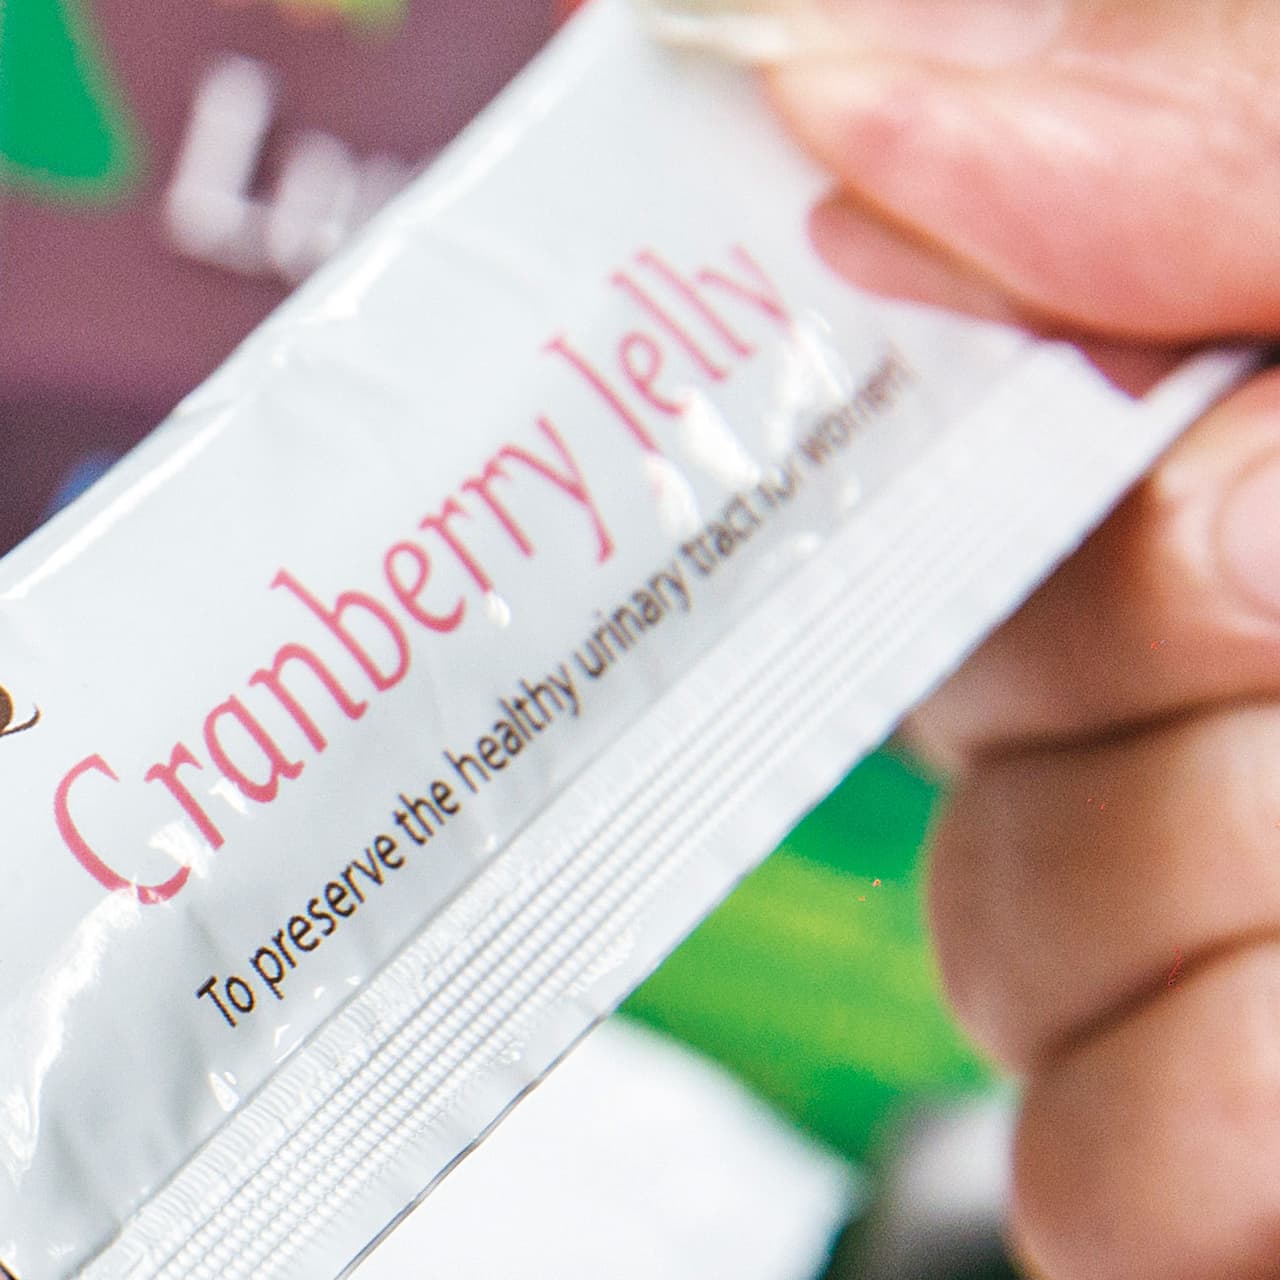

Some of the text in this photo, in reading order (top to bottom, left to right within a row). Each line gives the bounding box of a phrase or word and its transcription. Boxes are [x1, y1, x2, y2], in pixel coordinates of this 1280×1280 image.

[52, 238, 812, 906] Cranberry Jelly
[196, 975, 257, 1029] To
[248, 833, 407, 1001] preserve
[391, 778, 462, 847] the
[442, 661, 582, 794] healthy
[573, 558, 694, 680] urinary
[679, 490, 765, 578] tract
